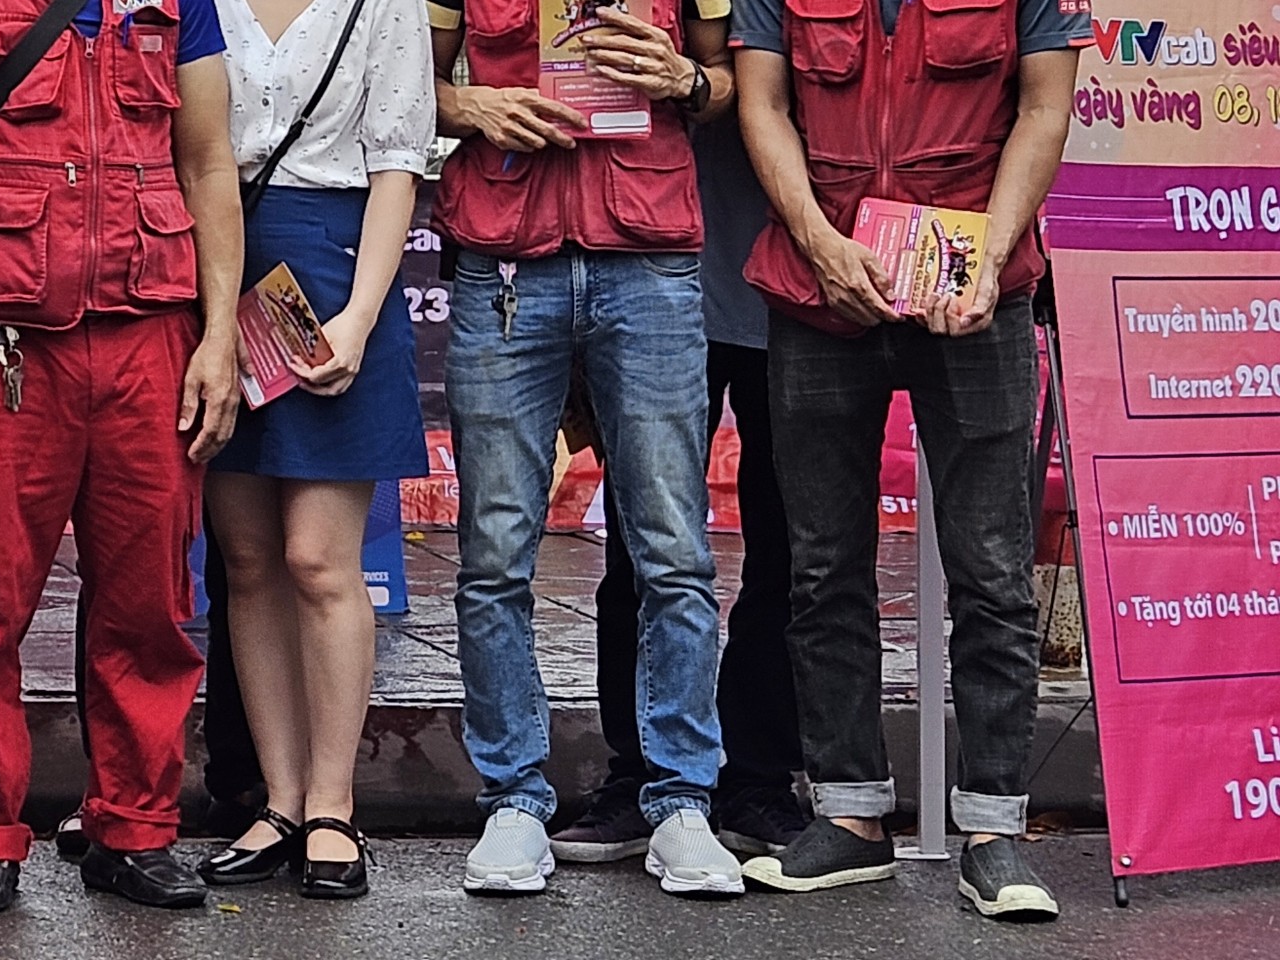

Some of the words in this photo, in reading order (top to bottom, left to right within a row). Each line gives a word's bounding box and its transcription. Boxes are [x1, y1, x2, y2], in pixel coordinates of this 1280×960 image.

[1092, 18, 1216, 66] VTVcab
[1073, 76, 1125, 130] gày
[1131, 77, 1202, 131] vàng
[1165, 185, 1254, 239] TRỌN
[1124, 303, 1197, 338] Truyền
[1201, 307, 1247, 332] hình
[1148, 374, 1233, 399] Internet
[1123, 505, 1178, 539] MIỄN
[1183, 512, 1245, 537] 100%
[1131, 595, 1181, 628] Tặng
[1184, 592, 1213, 618] tới
[1216, 593, 1241, 617] 04
